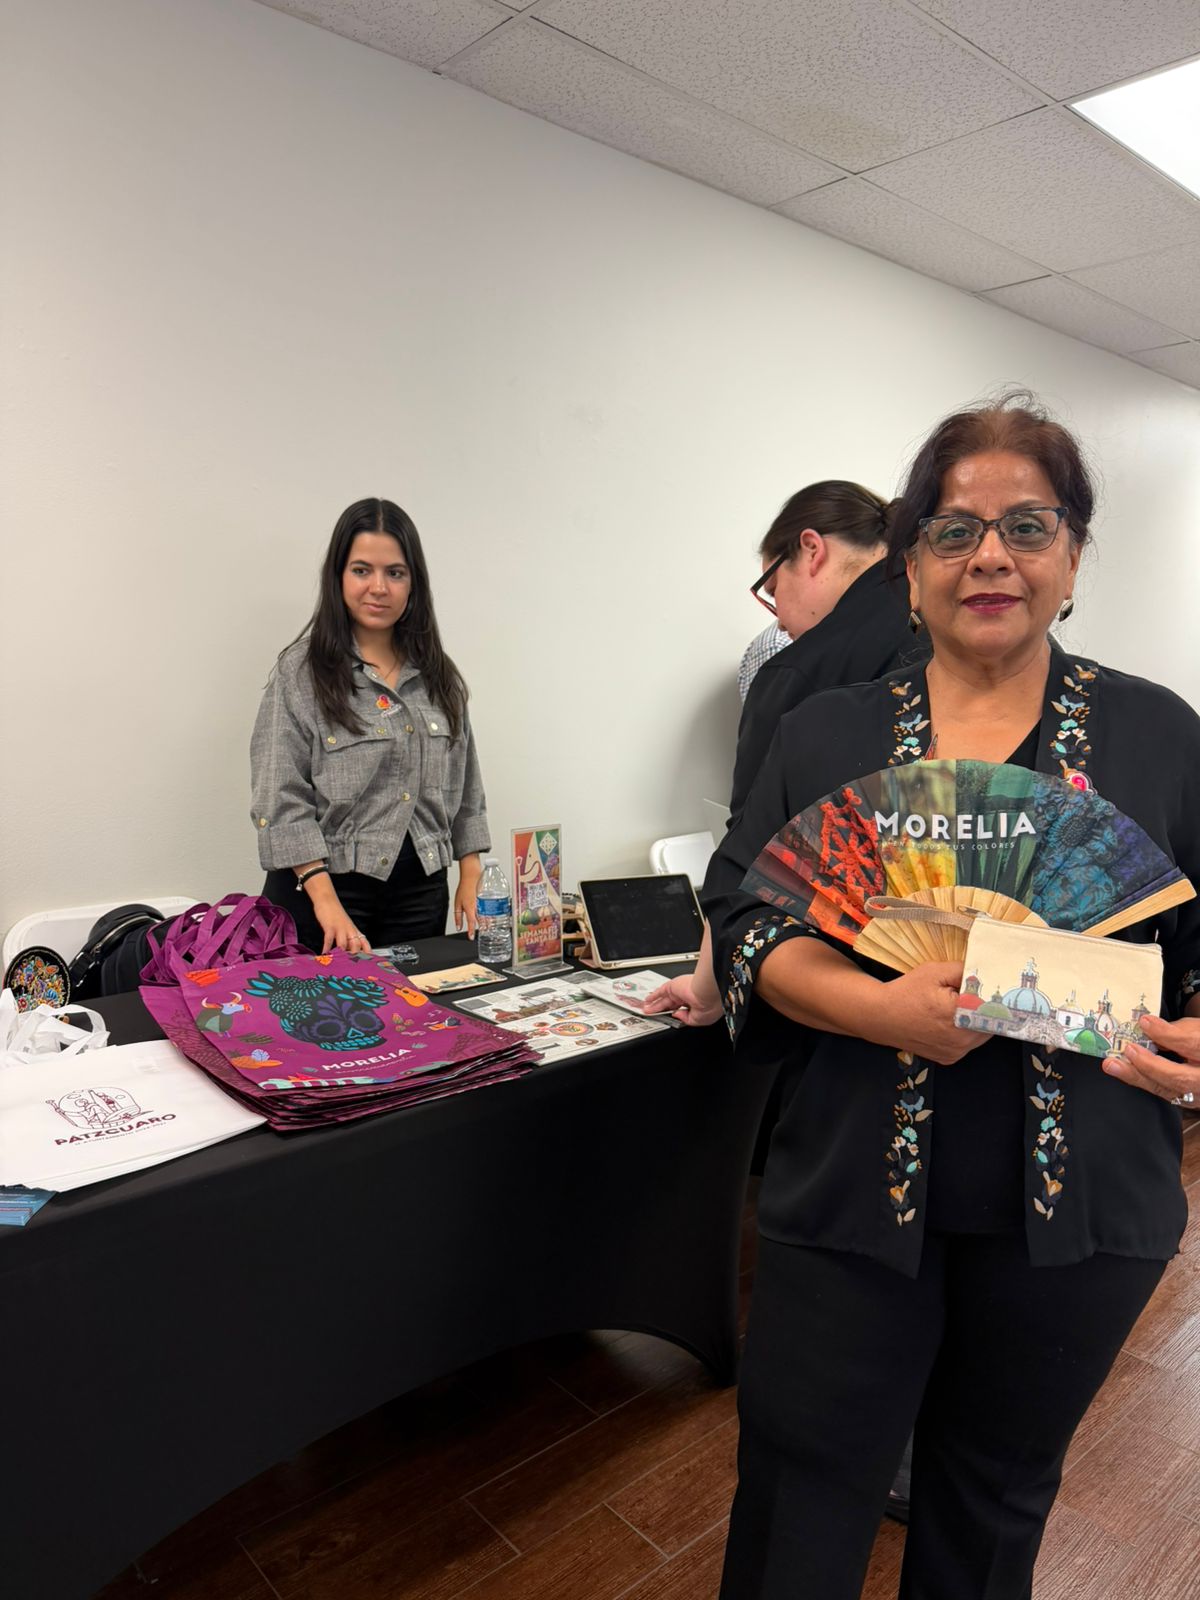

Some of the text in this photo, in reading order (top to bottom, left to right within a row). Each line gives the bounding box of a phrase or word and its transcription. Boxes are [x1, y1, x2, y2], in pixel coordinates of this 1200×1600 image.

[874, 811, 1036, 840] MORELIA
[972, 842, 1015, 850] COLORES
[322, 1049, 412, 1071] MORELIA
[54, 1114, 176, 1145] PATZCUARO
